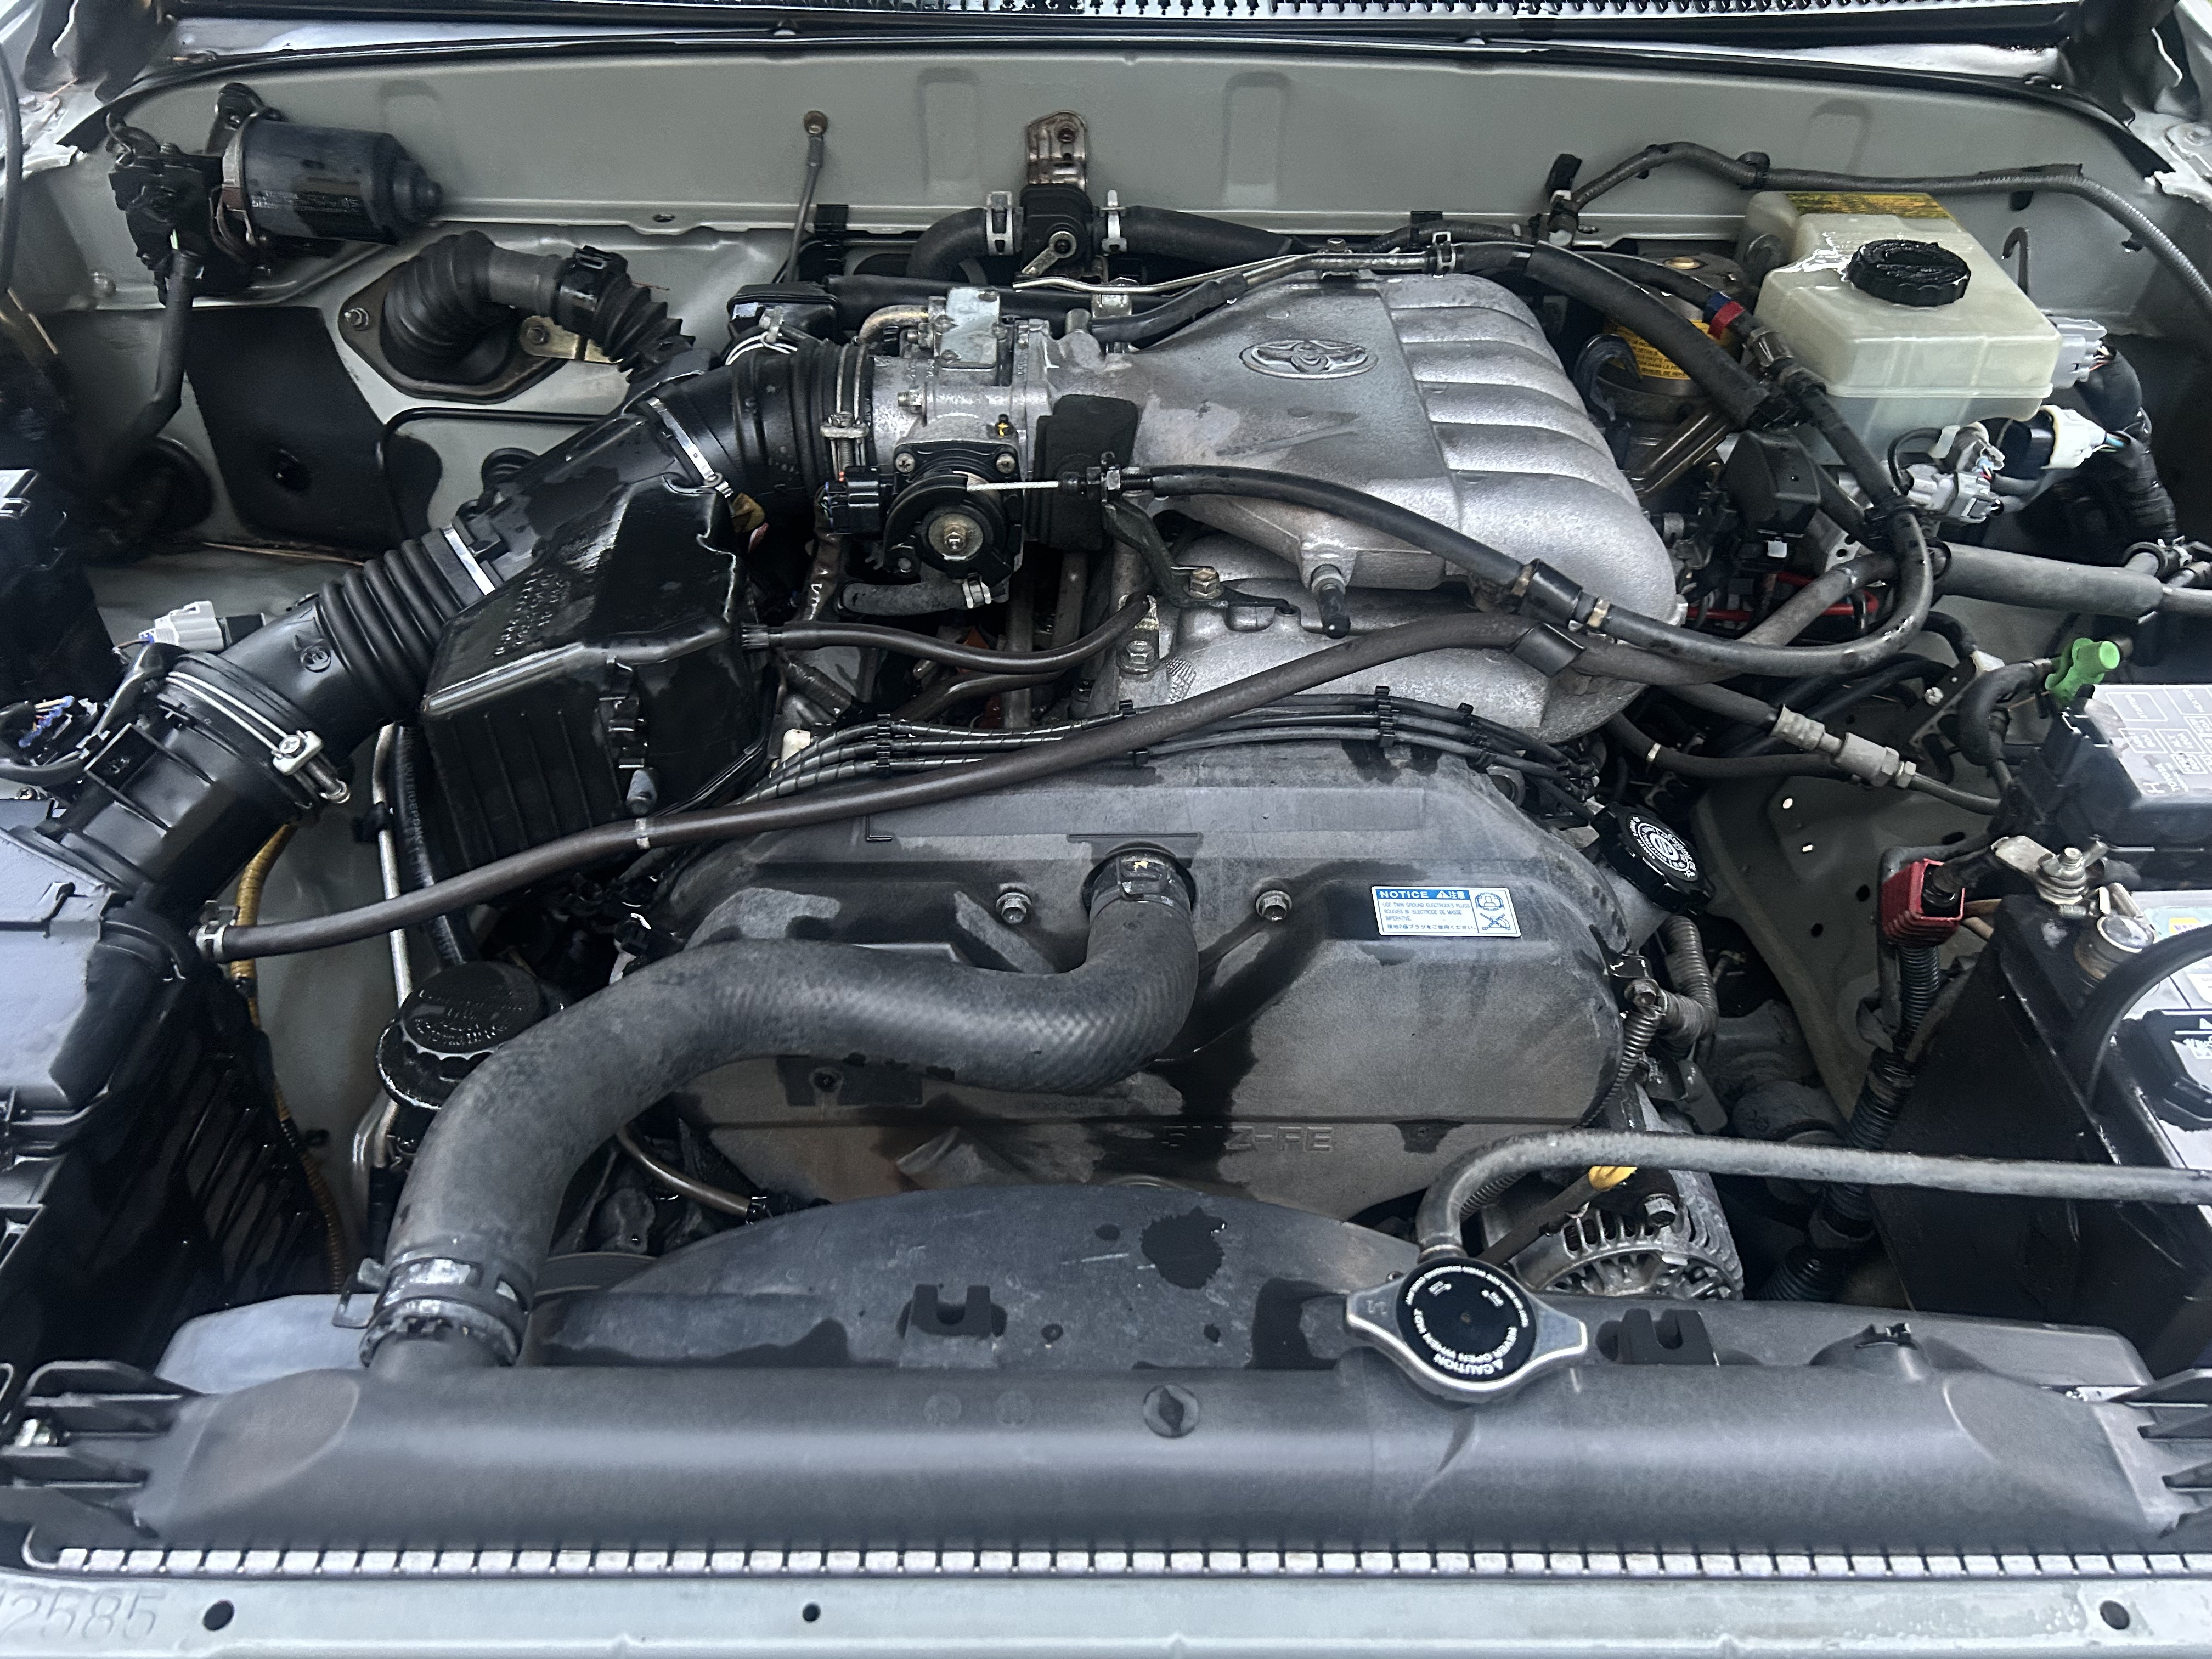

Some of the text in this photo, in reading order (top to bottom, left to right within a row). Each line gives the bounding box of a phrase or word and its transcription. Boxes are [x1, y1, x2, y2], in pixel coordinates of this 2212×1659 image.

[2125, 694, 2148, 719] STARTER
[2143, 782, 2165, 793] H
[2155, 763, 2180, 792] TOYOTA
[1414, 1308, 1518, 1363] NEVER OPEN WHEN HOT
[1432, 1352, 1494, 1375] CAUTION
